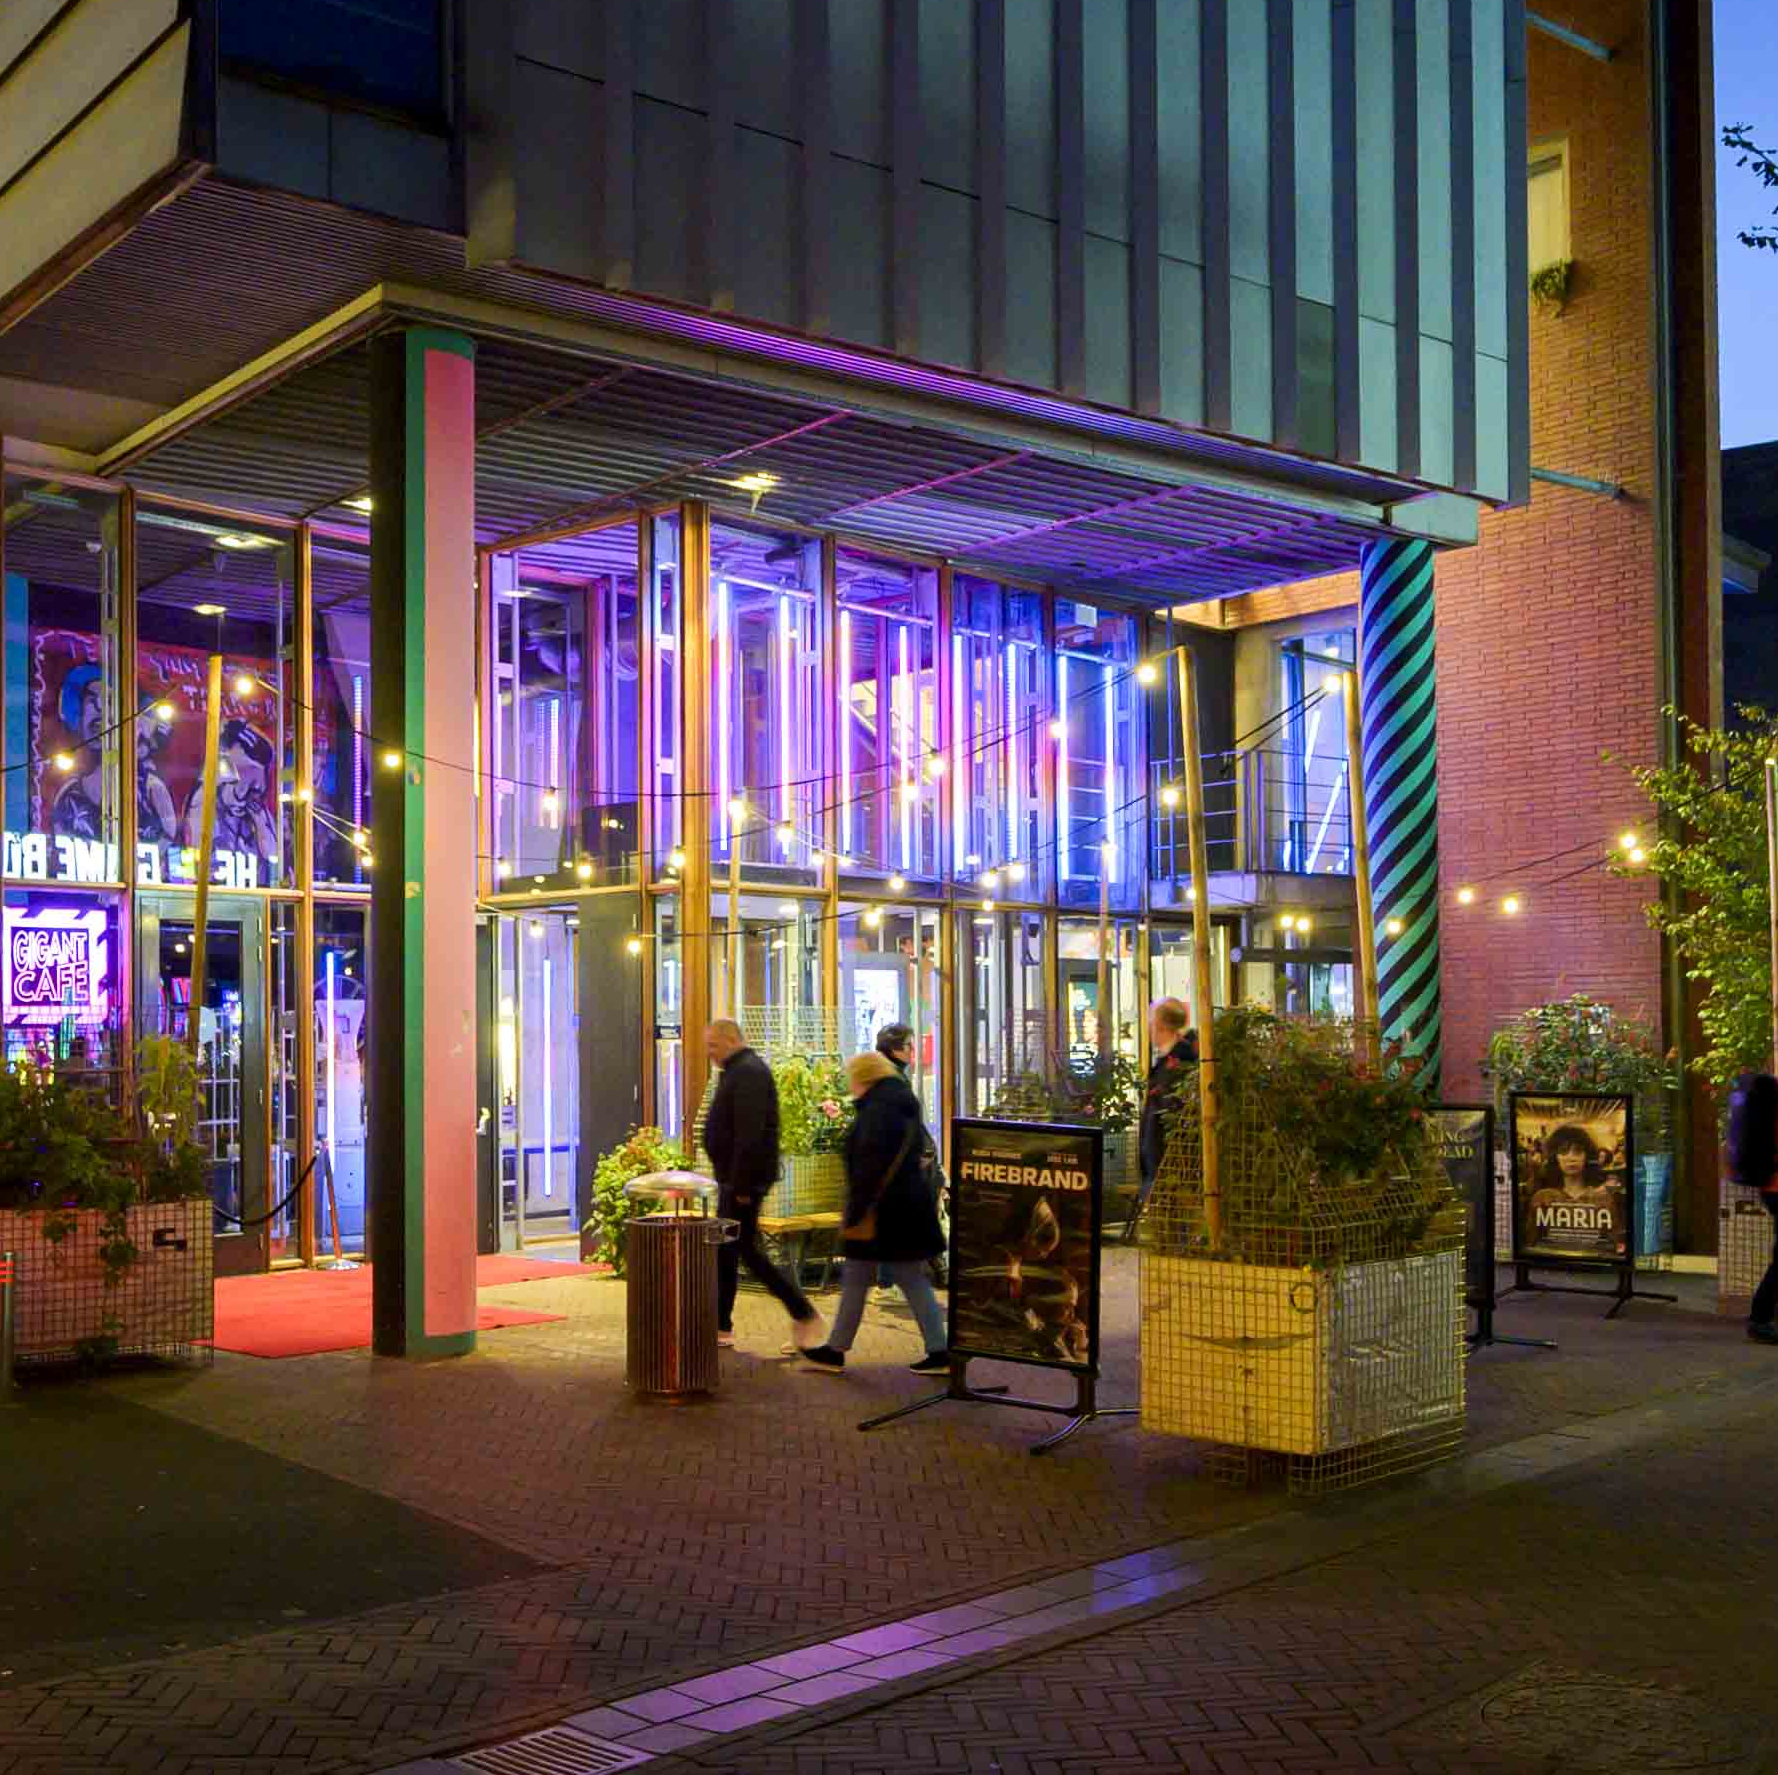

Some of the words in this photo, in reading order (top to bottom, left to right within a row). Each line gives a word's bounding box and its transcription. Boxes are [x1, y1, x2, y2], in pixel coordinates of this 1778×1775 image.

[12, 928, 89, 973] GIGANT
[13, 962, 89, 1003] CAFE
[960, 1161, 1089, 1192] FIREBRAND
[1535, 1207, 1613, 1230] MARIA
